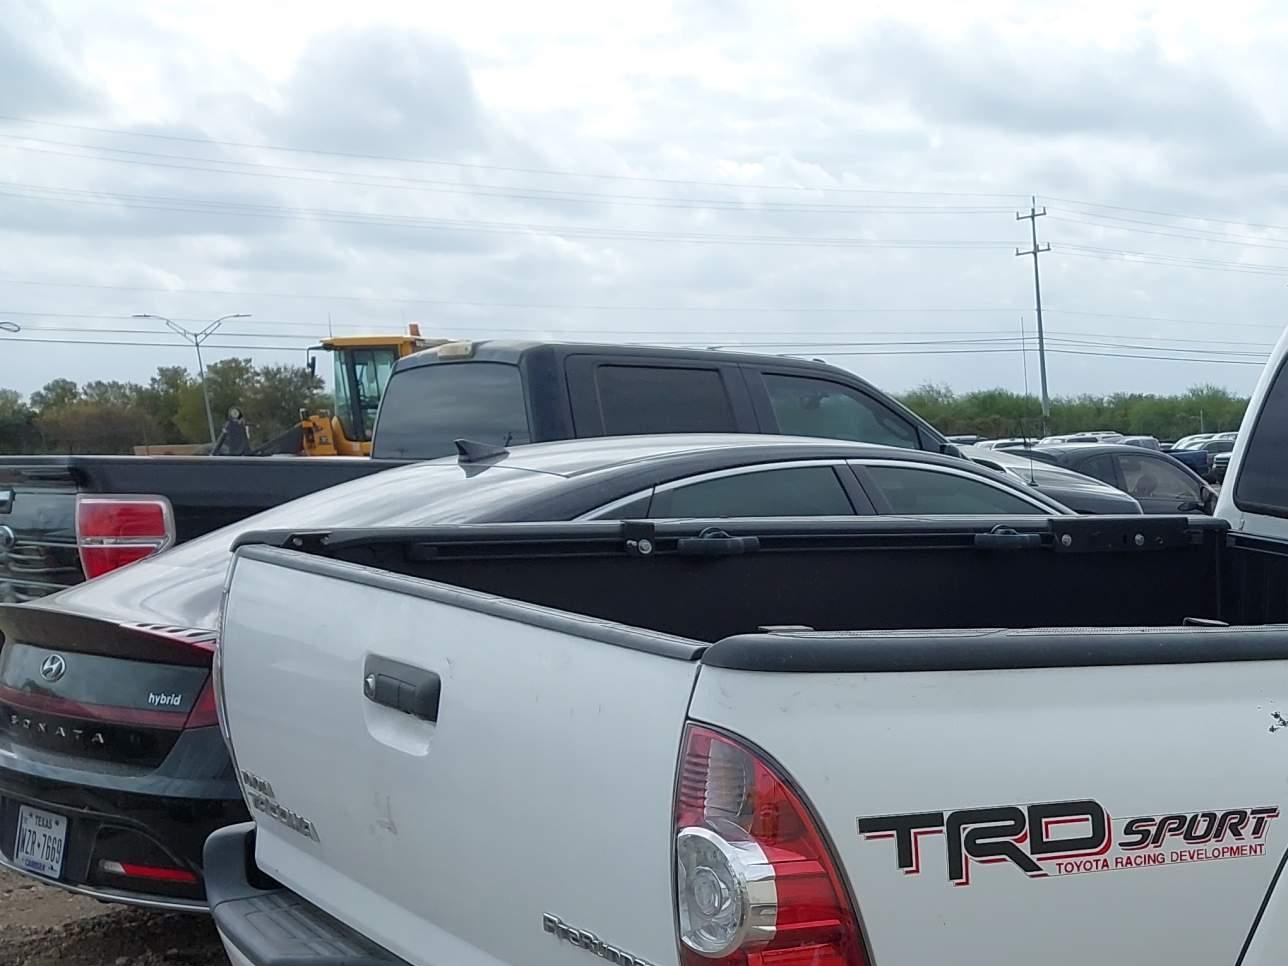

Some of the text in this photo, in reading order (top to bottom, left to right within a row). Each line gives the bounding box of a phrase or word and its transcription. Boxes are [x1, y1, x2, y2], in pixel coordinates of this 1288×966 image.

[148, 692, 182, 706] hybrid
[10, 714, 105, 744] SONATA
[34, 814, 53, 830] TEXAS
[856, 799, 1280, 887] TRD SPORT
[1055, 843, 1265, 875] TOYOTA RACING DEVELOPMENT
